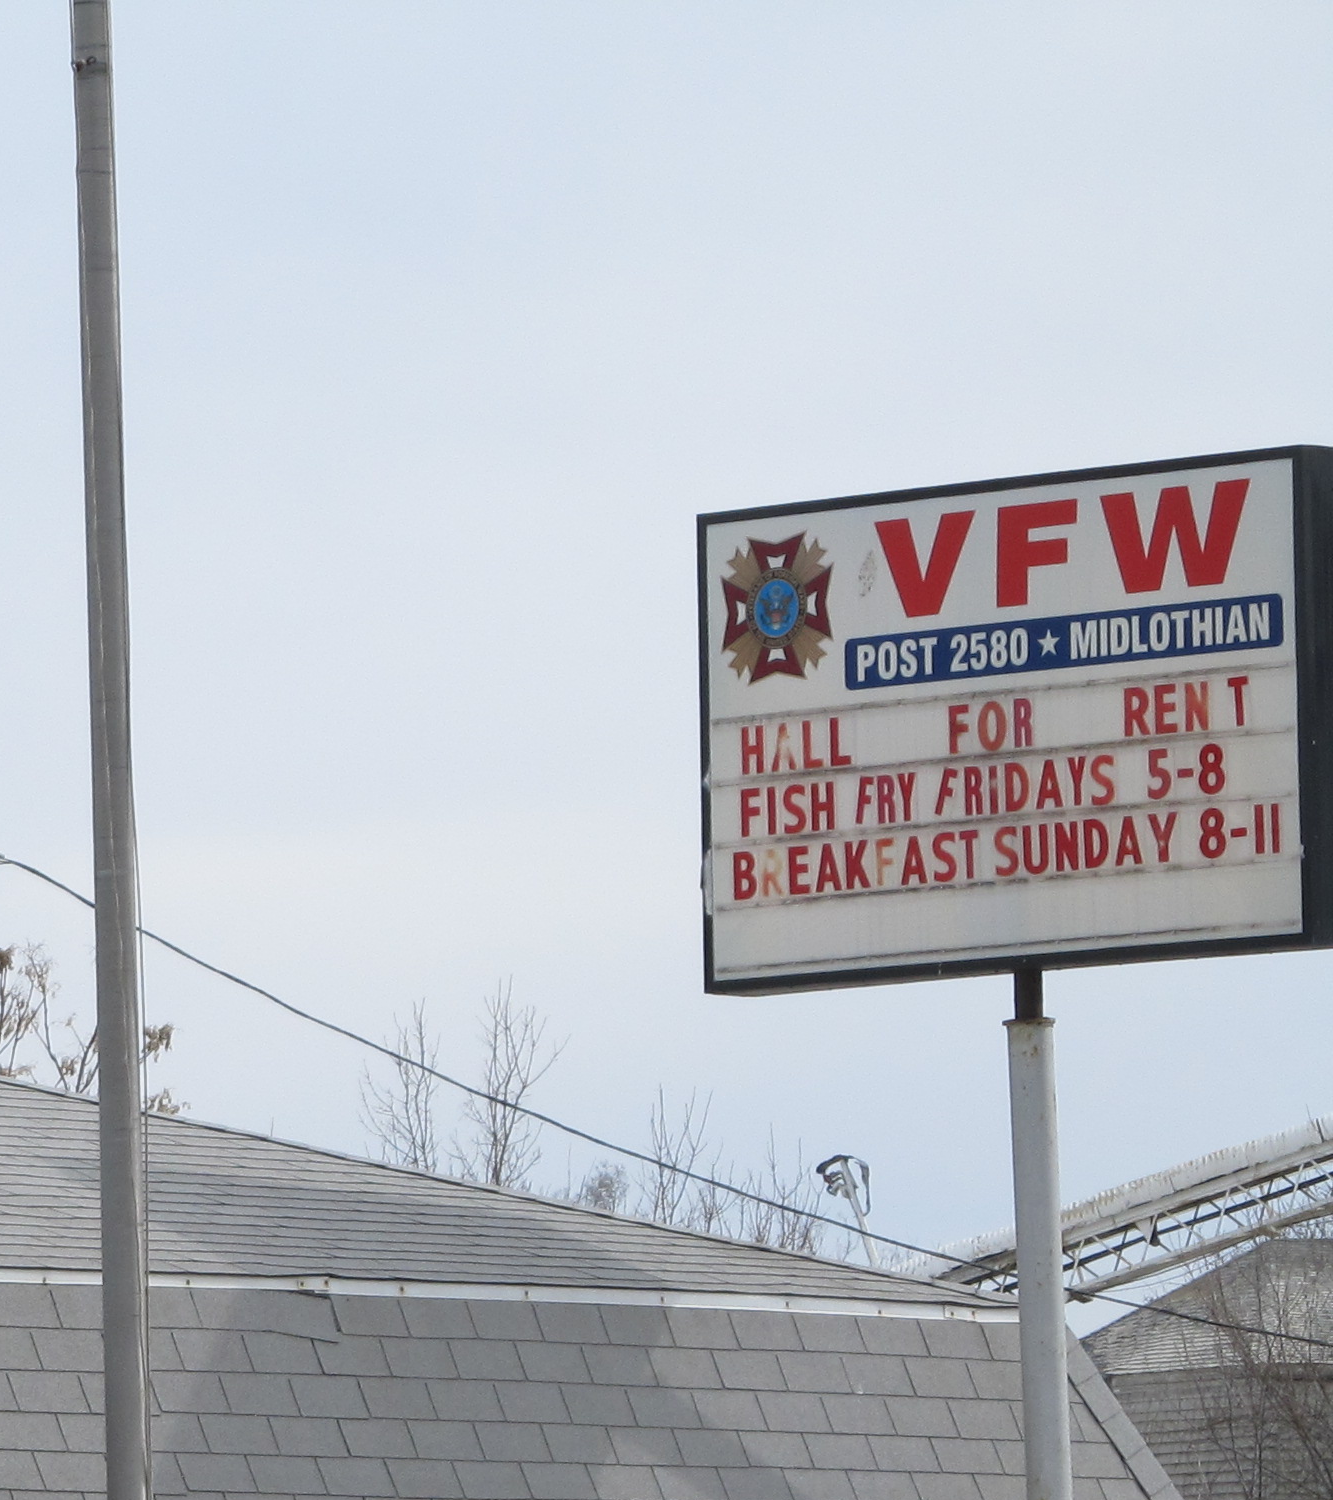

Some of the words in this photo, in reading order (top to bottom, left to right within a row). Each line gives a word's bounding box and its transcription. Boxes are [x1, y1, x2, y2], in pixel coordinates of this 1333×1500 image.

[874, 478, 1250, 618] VFW
[856, 637, 937, 682] POST
[950, 627, 1029, 673] 2580
[1070, 602, 1271, 660] MIDLOTHIAN
[741, 717, 852, 775] HALL
[948, 698, 1033, 754] FOR
[1123, 676, 1249, 738] RENT
[741, 782, 834, 837] FISH
[855, 772, 916, 825] FRY
[934, 754, 1115, 816] FRIDAYS
[1147, 744, 1226, 800] 5-8
[733, 829, 979, 901] BREAKFAST
[993, 811, 1177, 876] SUNDAY
[1199, 803, 1281, 860] 8-11
